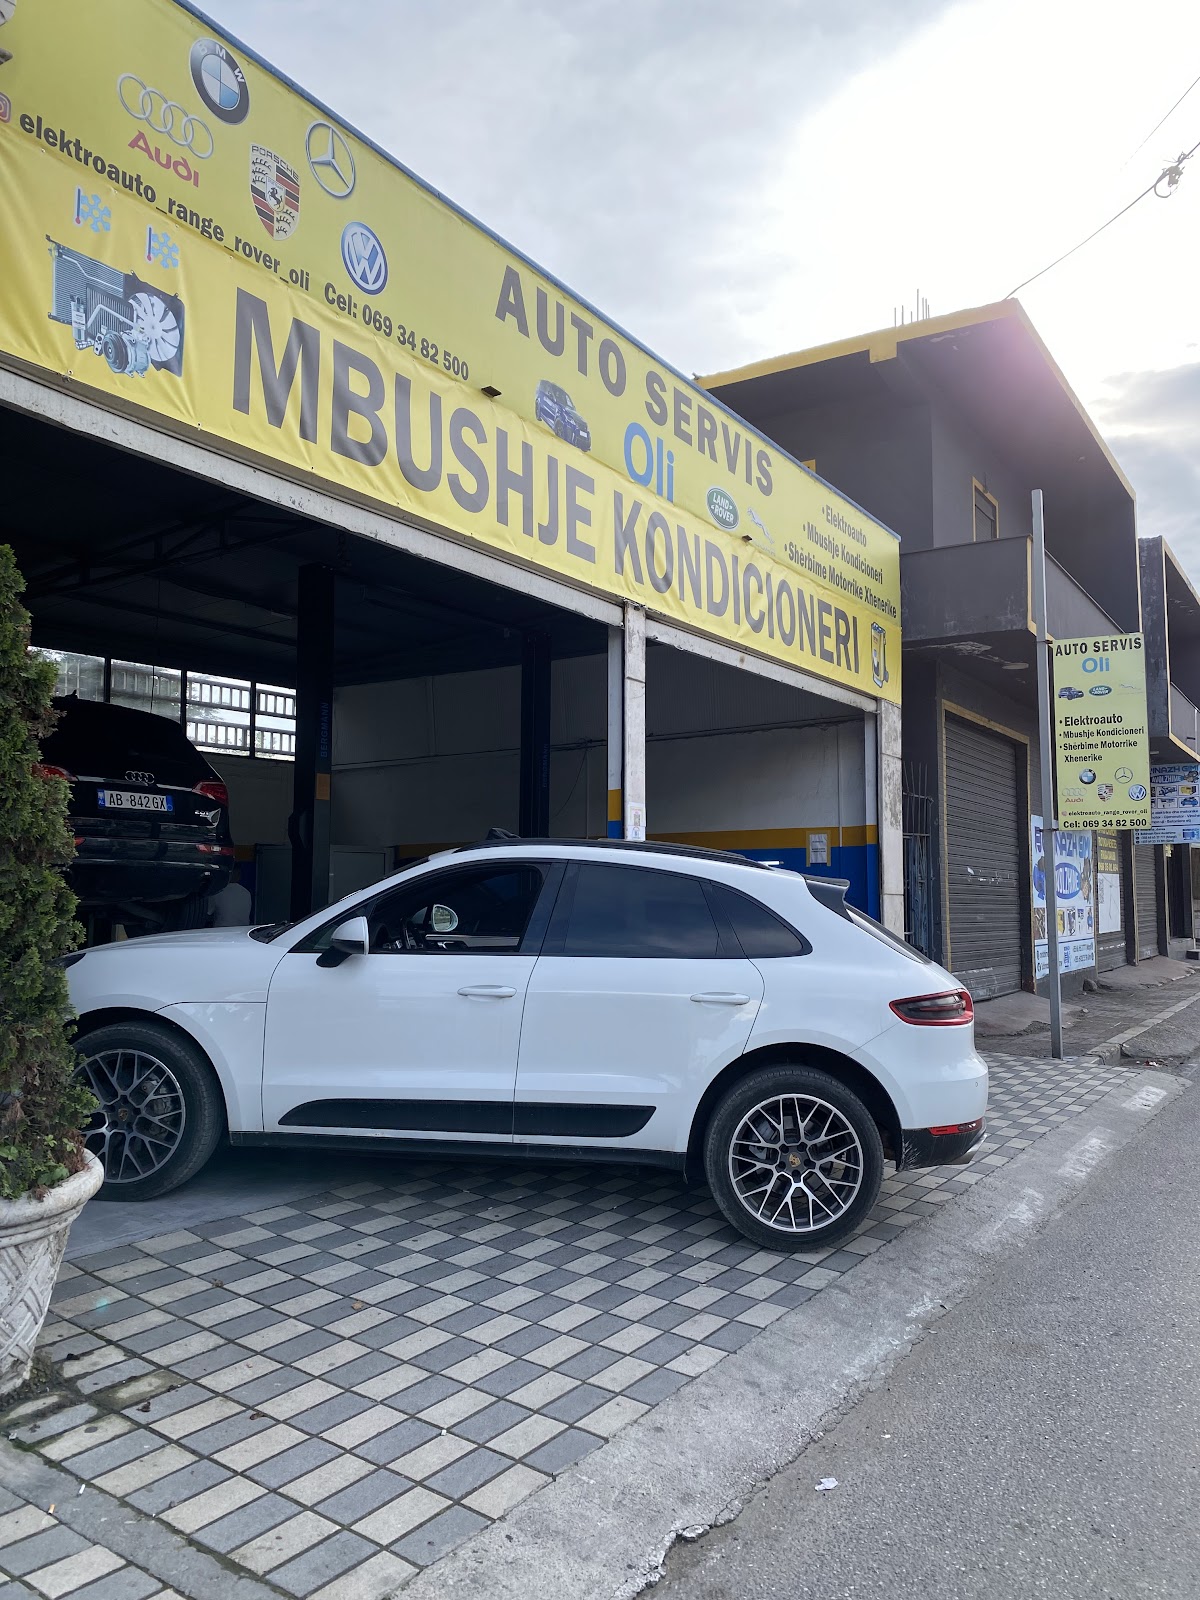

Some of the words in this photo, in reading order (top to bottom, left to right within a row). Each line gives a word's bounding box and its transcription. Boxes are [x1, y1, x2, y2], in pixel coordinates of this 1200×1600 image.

[128, 130, 200, 188] Audi
[251, 144, 300, 182] PORSCHE
[324, 282, 357, 319] Cel:
[362, 303, 393, 337] 069
[396, 324, 417, 351] 34
[420, 338, 439, 365] 82
[442, 349, 469, 381] 500
[494, 264, 627, 397] AUTO
[644, 370, 773, 497] SERVIS
[623, 422, 675, 504] Oli
[232, 286, 596, 564] MBUSHJE
[613, 489, 860, 674] KONDICIONERI
[712, 492, 730, 510] LAND
[714, 506, 734, 524] ROVER
[825, 504, 867, 548] Elektroauto
[806, 521, 840, 558] Mbushje
[841, 543, 883, 584] Kondicioneri
[828, 565, 864, 600] Motorrike
[864, 585, 897, 619] Xhenerike
[1055, 642, 1088, 657] AUTO
[1093, 637, 1142, 653] SERVIS
[1081, 656, 1110, 673] Oli
[320, 702, 329, 758] BERGMANN
[1063, 729, 1095, 739] Mbushje
[1096, 726, 1144, 736] Kondicioneri
[1064, 713, 1123, 727] Elektroauto
[1064, 753, 1103, 763] Xhenerike
[1100, 739, 1138, 749] Motorrike
[109, 793, 123, 806] AB
[129, 794, 151, 808] 842
[152, 796, 166, 810] GX
[1063, 820, 1080, 828] Cel:
[1082, 819, 1099, 828] 069
[1101, 819, 1113, 827] 34
[1115, 819, 1127, 827] 82
[1129, 818, 1147, 827] 500
